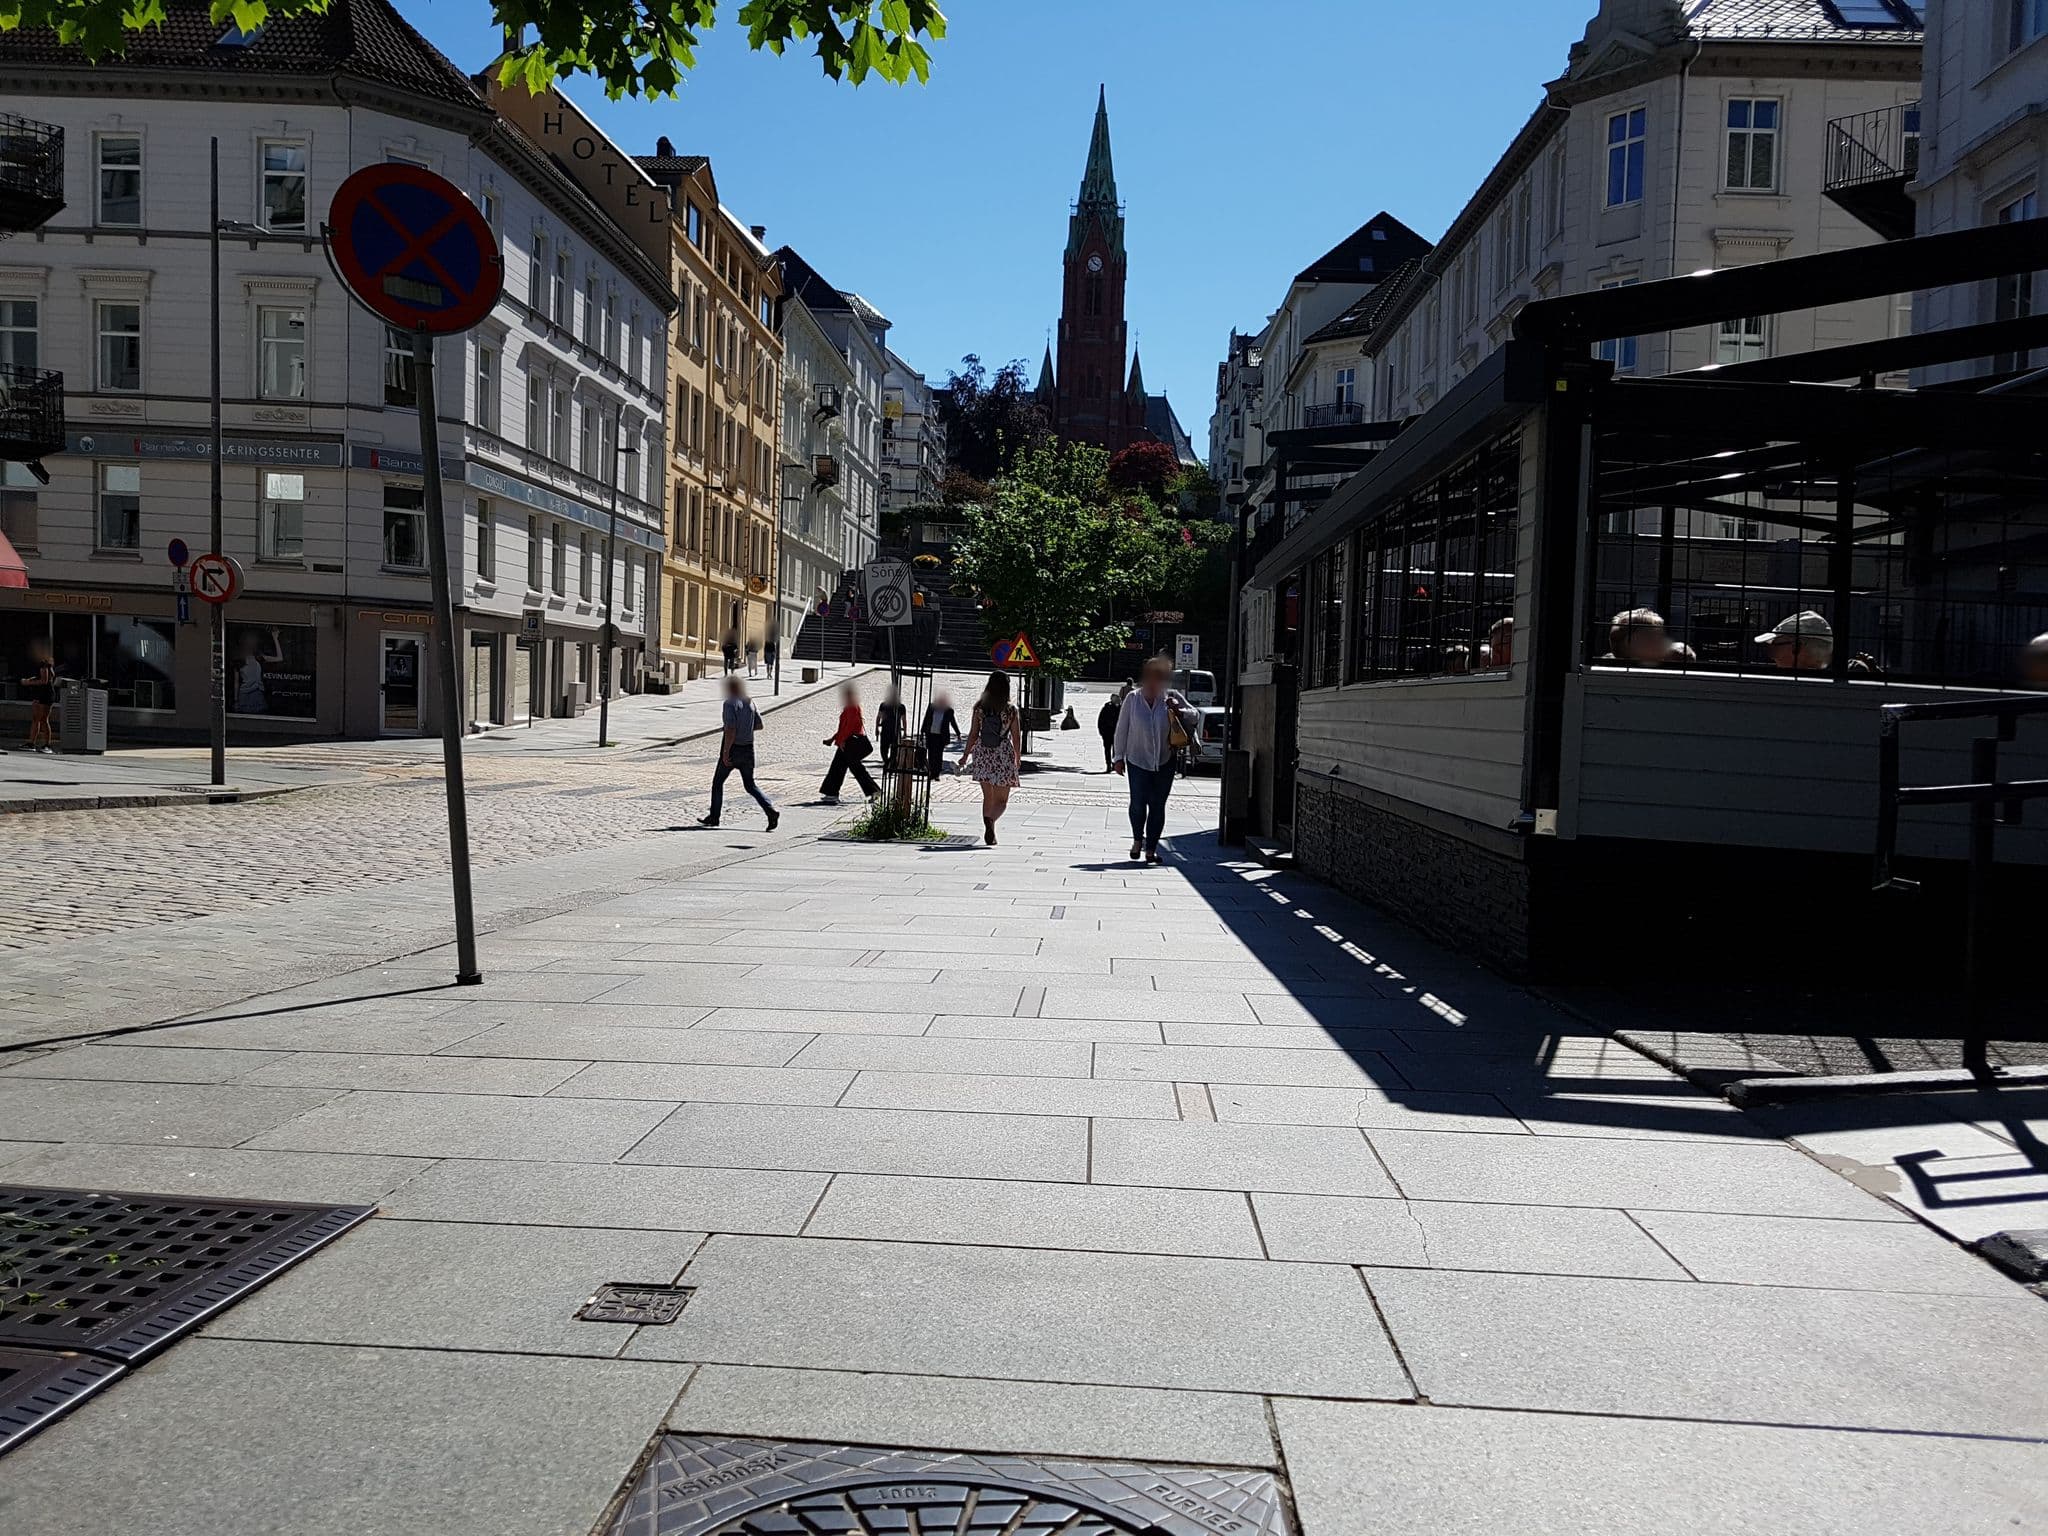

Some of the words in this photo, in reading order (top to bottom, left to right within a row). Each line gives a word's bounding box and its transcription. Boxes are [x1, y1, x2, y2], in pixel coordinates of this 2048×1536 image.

[543, 112, 664, 224] HOTEL
[195, 442, 321, 460] OPLÆRINGSSENTER
[378, 455, 449, 474] Ramsk
[485, 473, 508, 491] CONSULT
[357, 610, 435, 625] ram
[1145, 1483, 1243, 1533] FURNES
